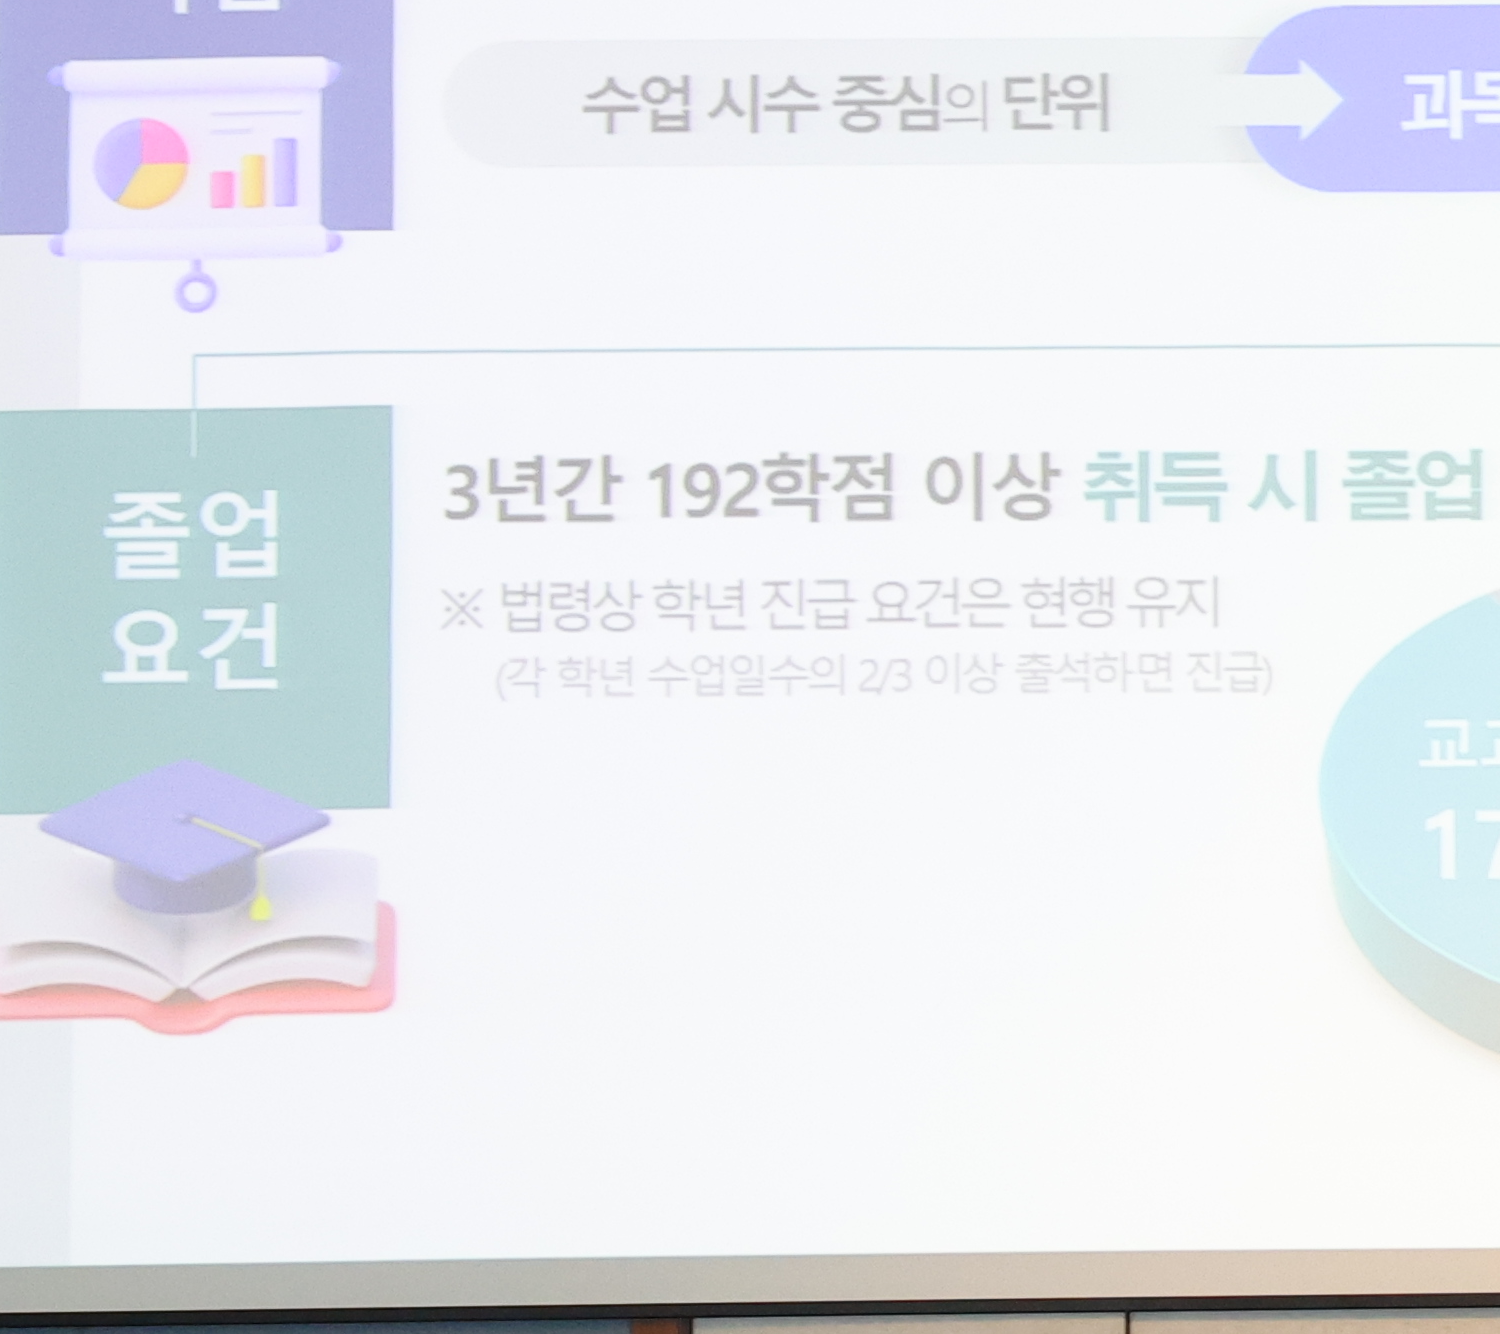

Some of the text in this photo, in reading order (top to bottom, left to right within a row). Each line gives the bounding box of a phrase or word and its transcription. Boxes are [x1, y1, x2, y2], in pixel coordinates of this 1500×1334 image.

[581, 72, 1110, 135] 수업 시수 중심의 단위
[443, 446, 1484, 524] 3년간 192학점 이상 취득 시 졸업
[103, 489, 279, 580] 졸업
[500, 579, 644, 634] 법령상
[651, 578, 748, 633] 학년
[761, 578, 858, 631] 진급
[864, 576, 1012, 630] 요건은
[1020, 575, 1116, 630] 현행
[1126, 575, 1220, 629] 유지
[102, 602, 279, 690] 요건
[494, 649, 1274, 703] (각 학년 수업일수의 2/3 이상 출석하면 진급)
